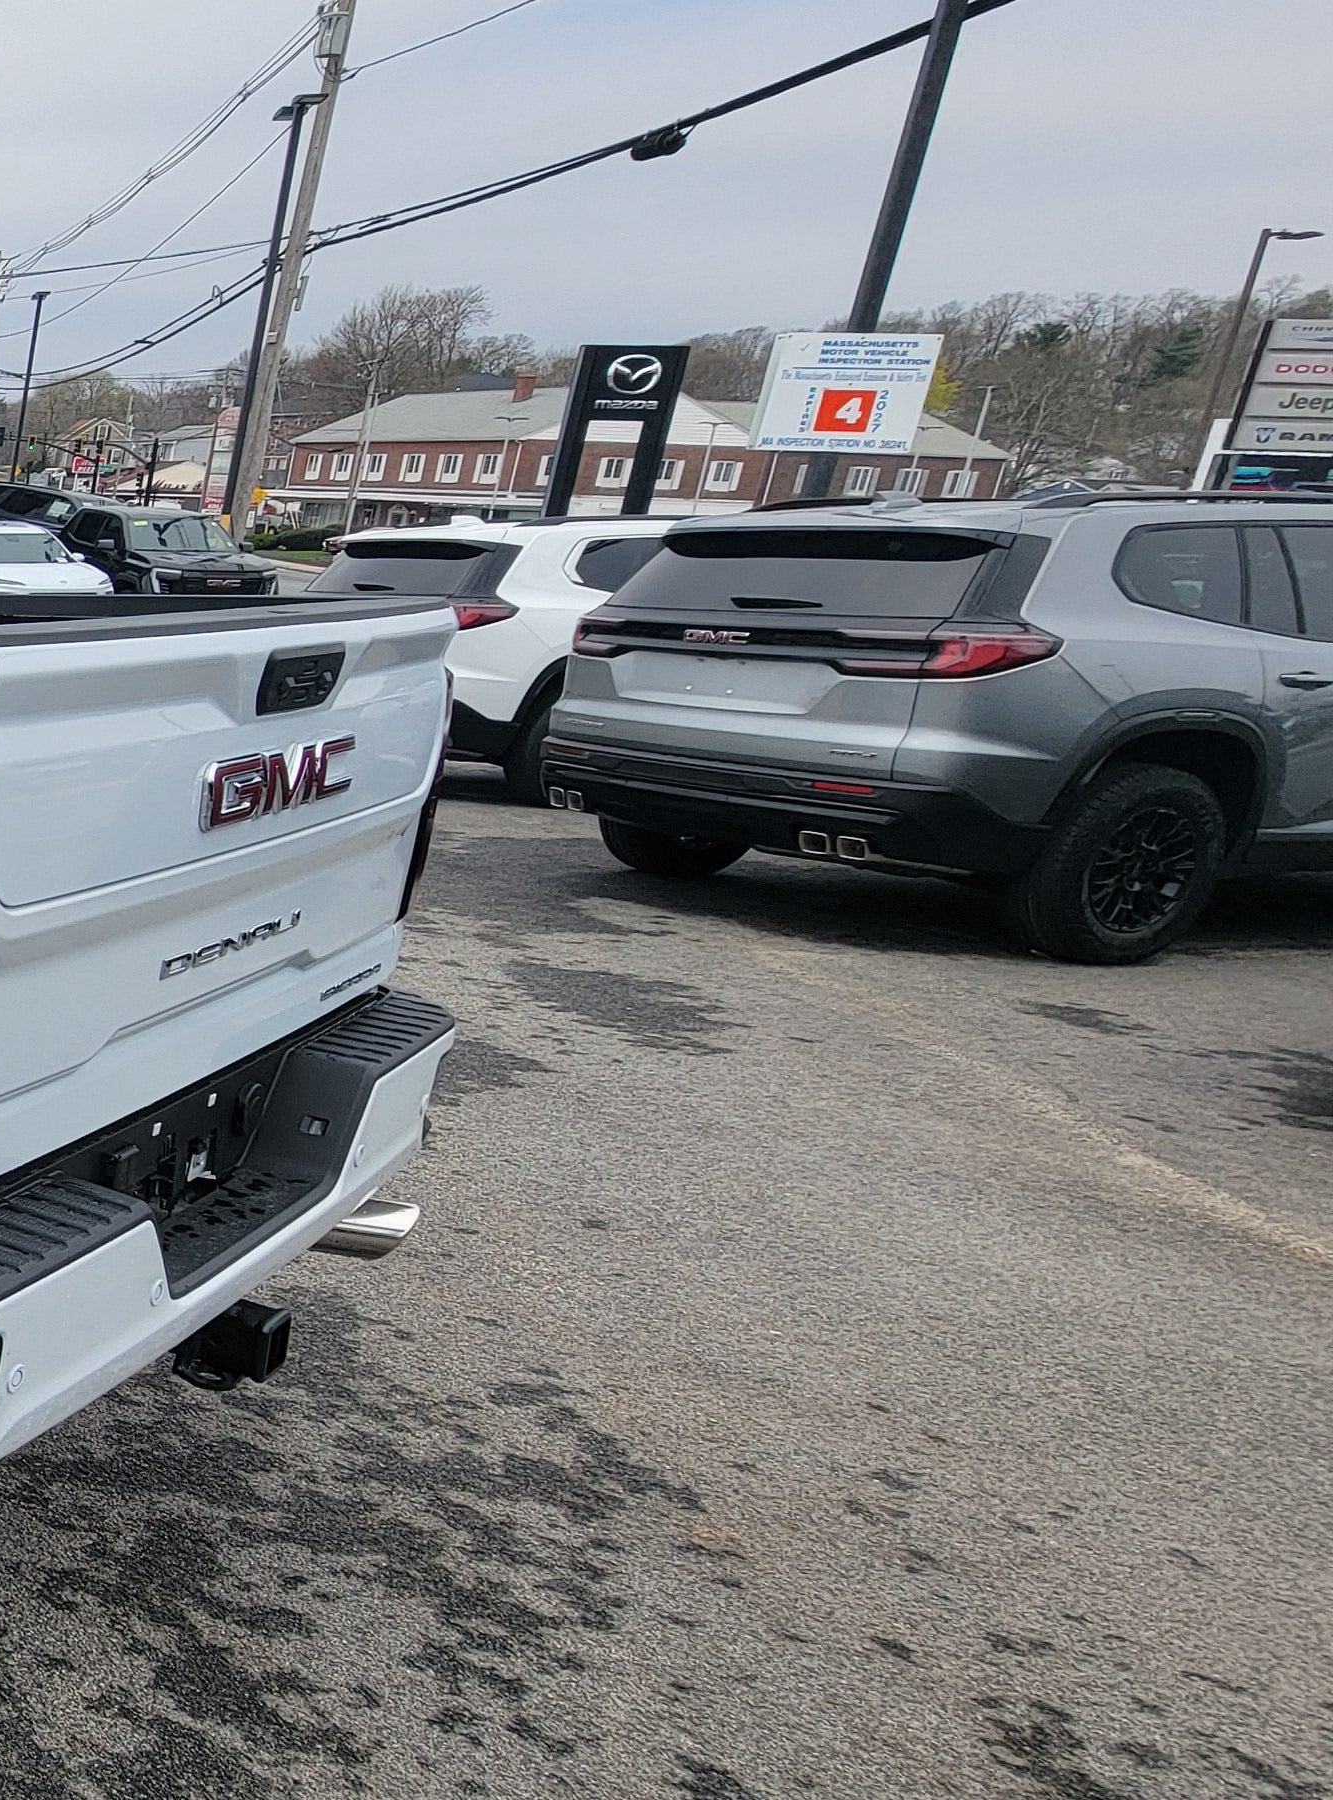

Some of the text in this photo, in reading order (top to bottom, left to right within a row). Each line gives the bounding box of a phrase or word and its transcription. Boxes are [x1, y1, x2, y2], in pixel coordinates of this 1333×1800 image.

[822, 340, 920, 348] MASSACHUSETTS
[1276, 364, 1333, 374] DOD
[835, 397, 863, 424] 4
[1278, 392, 1333, 414] Jeep
[776, 438, 825, 447] INSPECTION
[827, 438, 860, 448] STATION
[683, 629, 750, 644] GMC
[197, 732, 356, 833] GMC
[159, 907, 301, 981] DENALI
